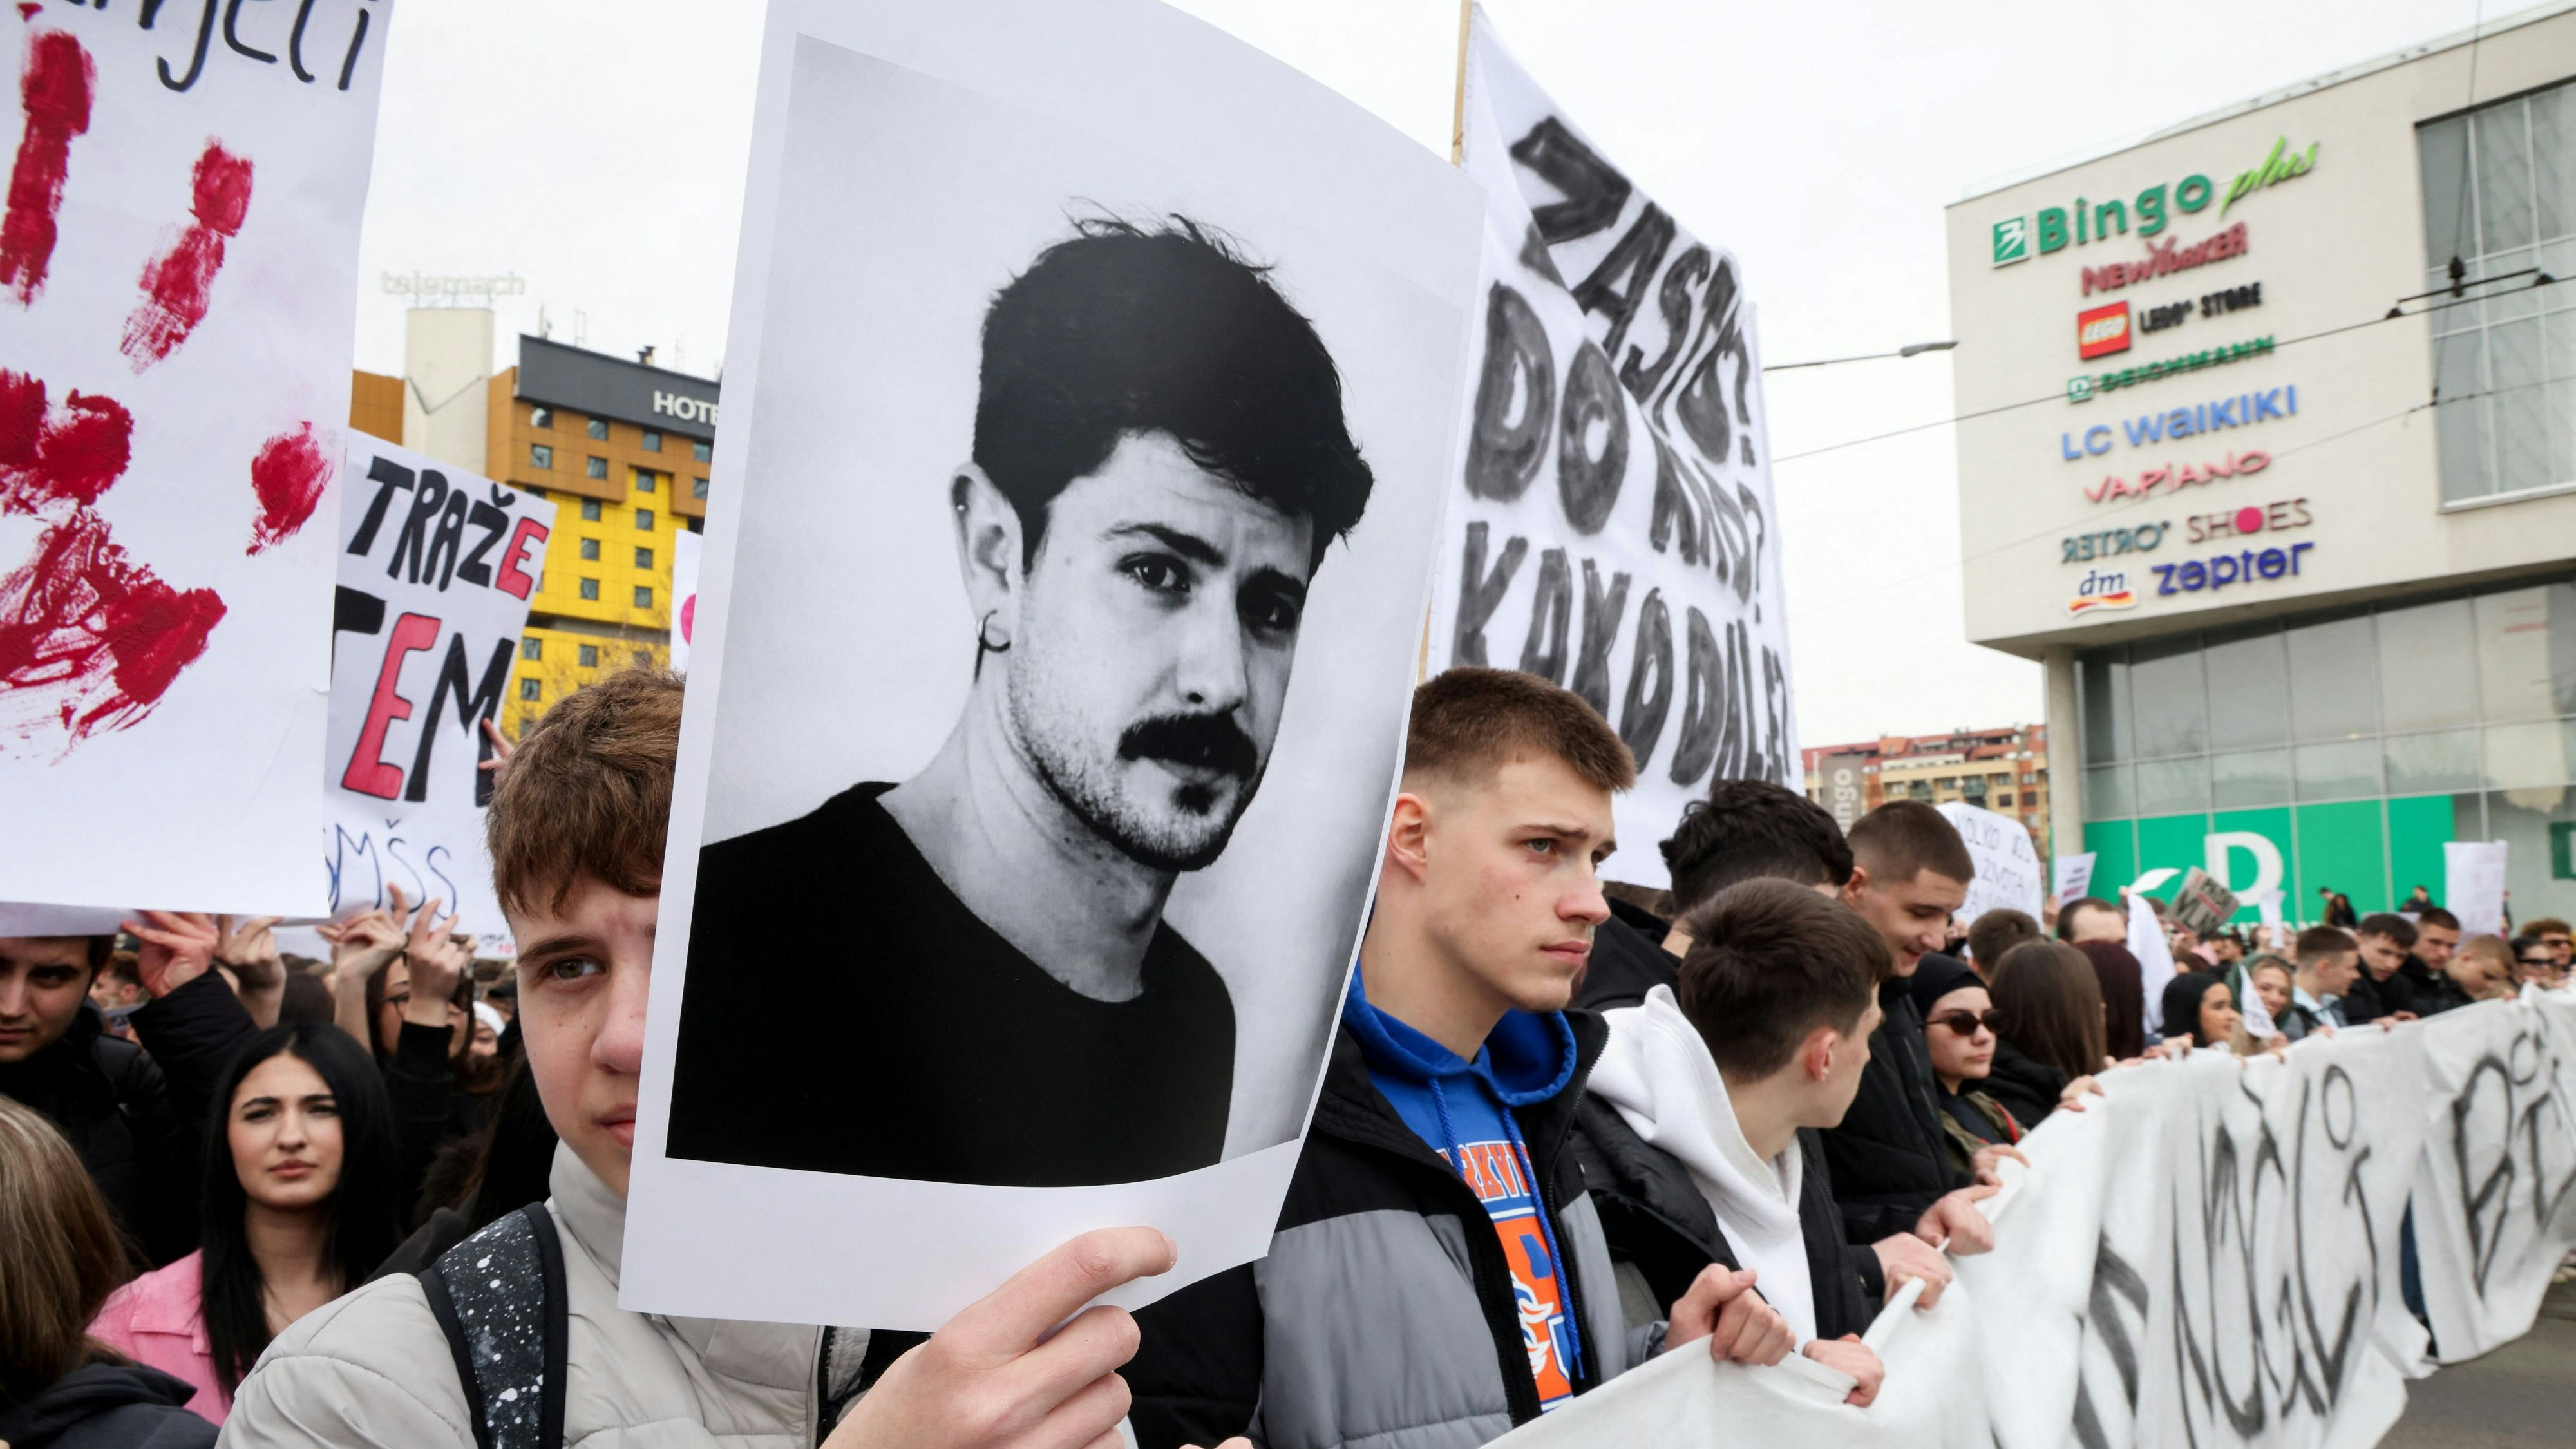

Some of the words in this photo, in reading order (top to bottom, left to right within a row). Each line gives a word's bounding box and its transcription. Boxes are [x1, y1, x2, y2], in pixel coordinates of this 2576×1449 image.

[2038, 174, 2213, 256] Bingo
[2219, 136, 2318, 219] plus
[381, 269, 526, 296] telemach
[2081, 315, 2128, 344] LEGO
[2201, 281, 2261, 318] STORE
[2100, 335, 2275, 392] DEICHMANN
[1464, 279, 1631, 537] DO
[2061, 424, 2113, 461] LC
[346, 455, 549, 601] TRAŽE
[2187, 498, 2313, 544] SHOES
[2079, 570, 2125, 598] dm
[2151, 541, 2316, 598] zepter
[1451, 520, 1674, 775] KAKO
[1833, 767, 1858, 838] ingo
